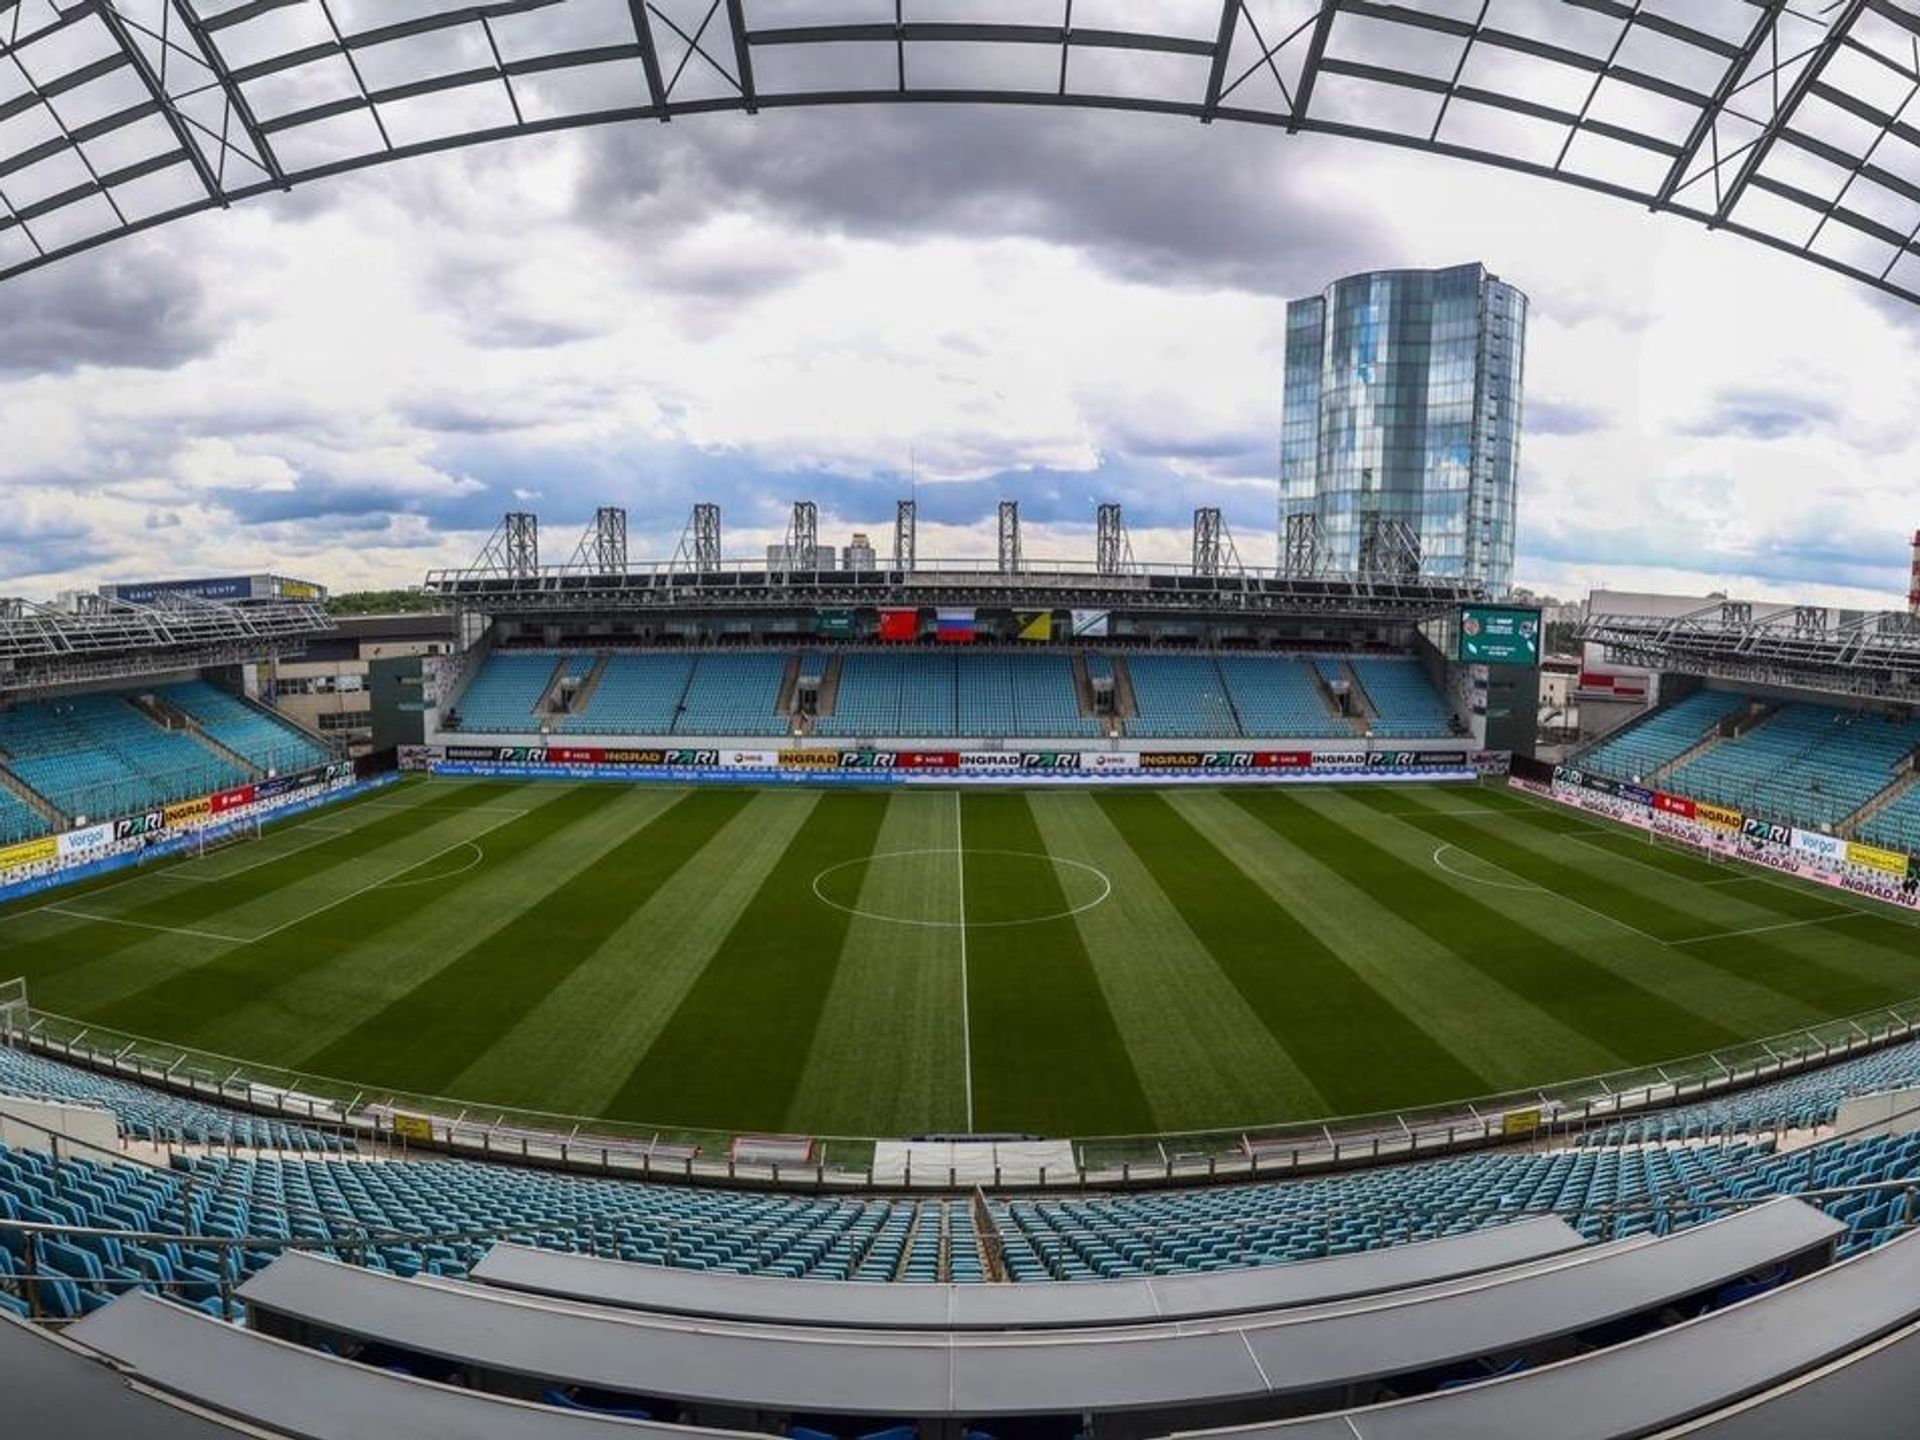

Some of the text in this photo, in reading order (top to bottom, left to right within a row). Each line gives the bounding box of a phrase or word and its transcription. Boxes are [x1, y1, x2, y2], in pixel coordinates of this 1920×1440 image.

[500, 748, 547, 760] PARI
[605, 751, 660, 762] INGRAD
[664, 750, 717, 764] PARI
[779, 754, 837, 764] INGRAD
[841, 753, 896, 766] PARI
[960, 756, 1019, 765] INGRAD
[1023, 754, 1078, 766] PARI
[1141, 756, 1198, 765] INGRAD
[1202, 754, 1254, 766] PARI
[1313, 754, 1365, 764] INGRAD
[166, 802, 209, 821] INGRAD
[1697, 807, 1740, 828] INGRAD
[117, 811, 162, 840] PARI
[1743, 818, 1789, 844] PARI
[1801, 836, 1836, 854] Vorgol
[1735, 847, 1800, 873] INGRAD.RU
[1840, 876, 1918, 907] INGRAD.RU
